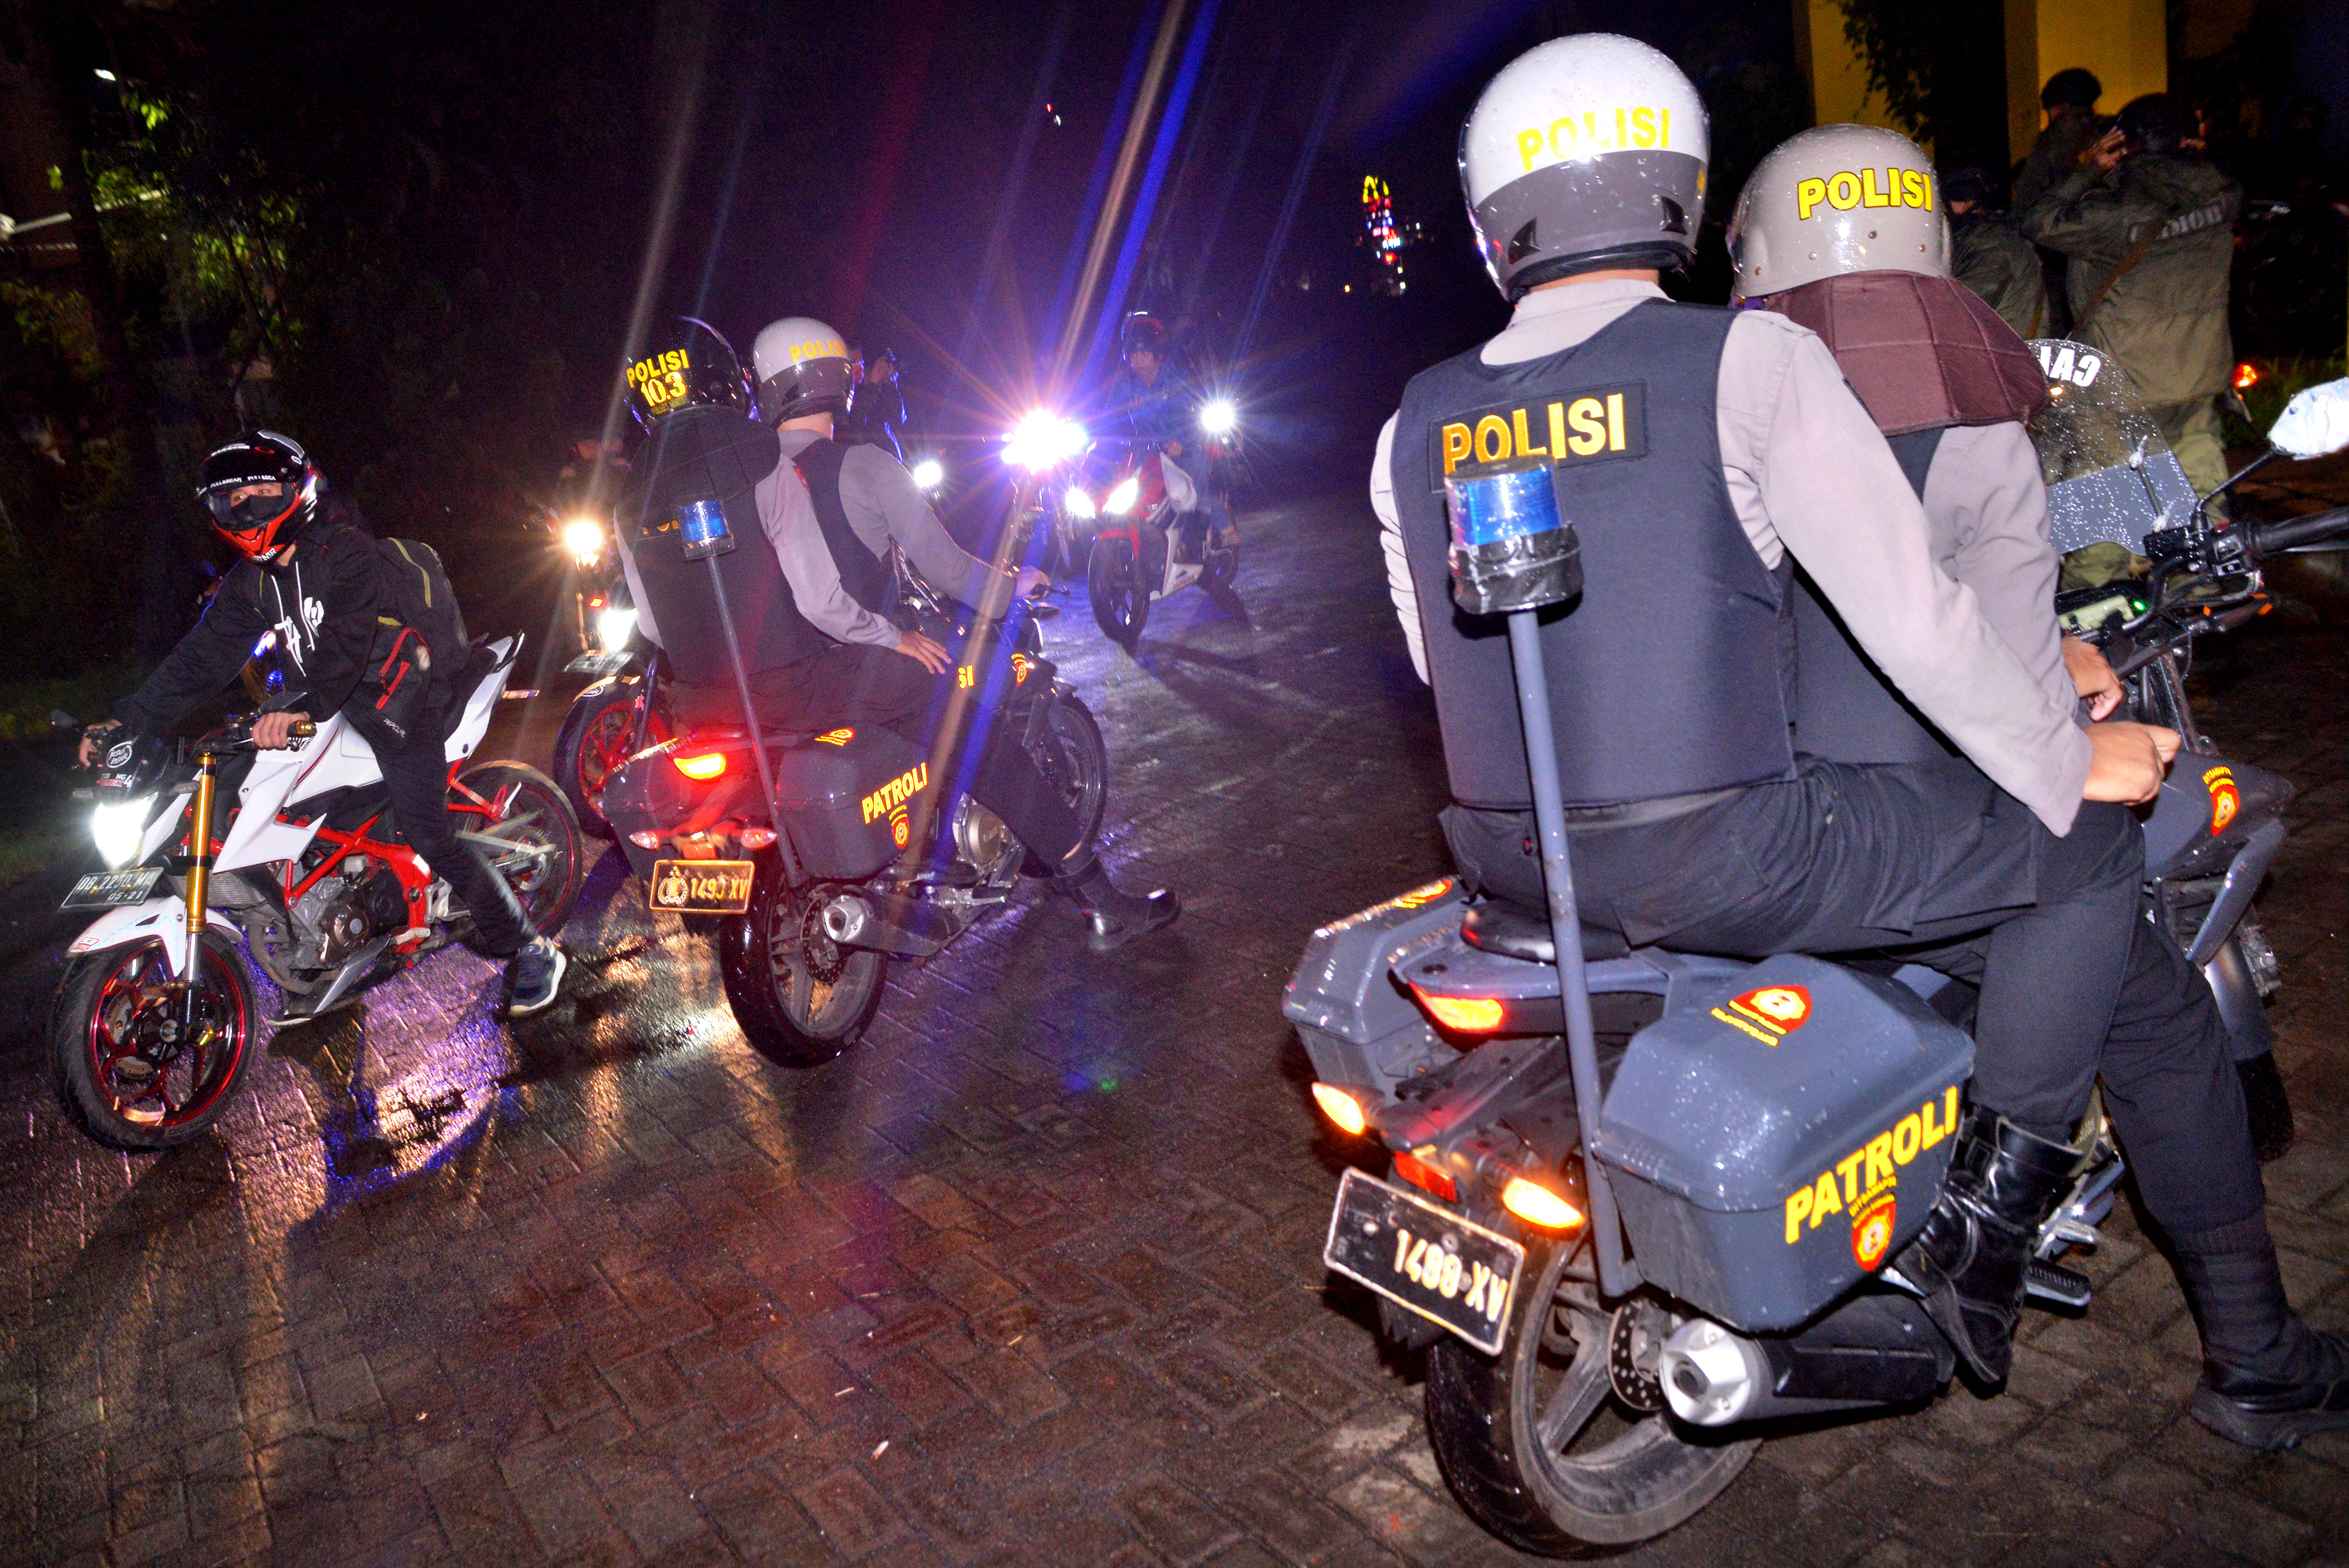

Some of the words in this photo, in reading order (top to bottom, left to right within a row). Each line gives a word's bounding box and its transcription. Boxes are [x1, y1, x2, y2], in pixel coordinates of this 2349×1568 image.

[1517, 105, 1670, 172] POLISI
[1798, 168, 1932, 220] POLISI
[626, 349, 689, 388] POLISI
[641, 371, 686, 406] 10.3
[1442, 393, 1626, 476] POLISI
[861, 762, 928, 825] PATROLI
[728, 879, 749, 900] XV
[1785, 1085, 1957, 1244] PATROLI
[1464, 1260, 1508, 1322] XV
